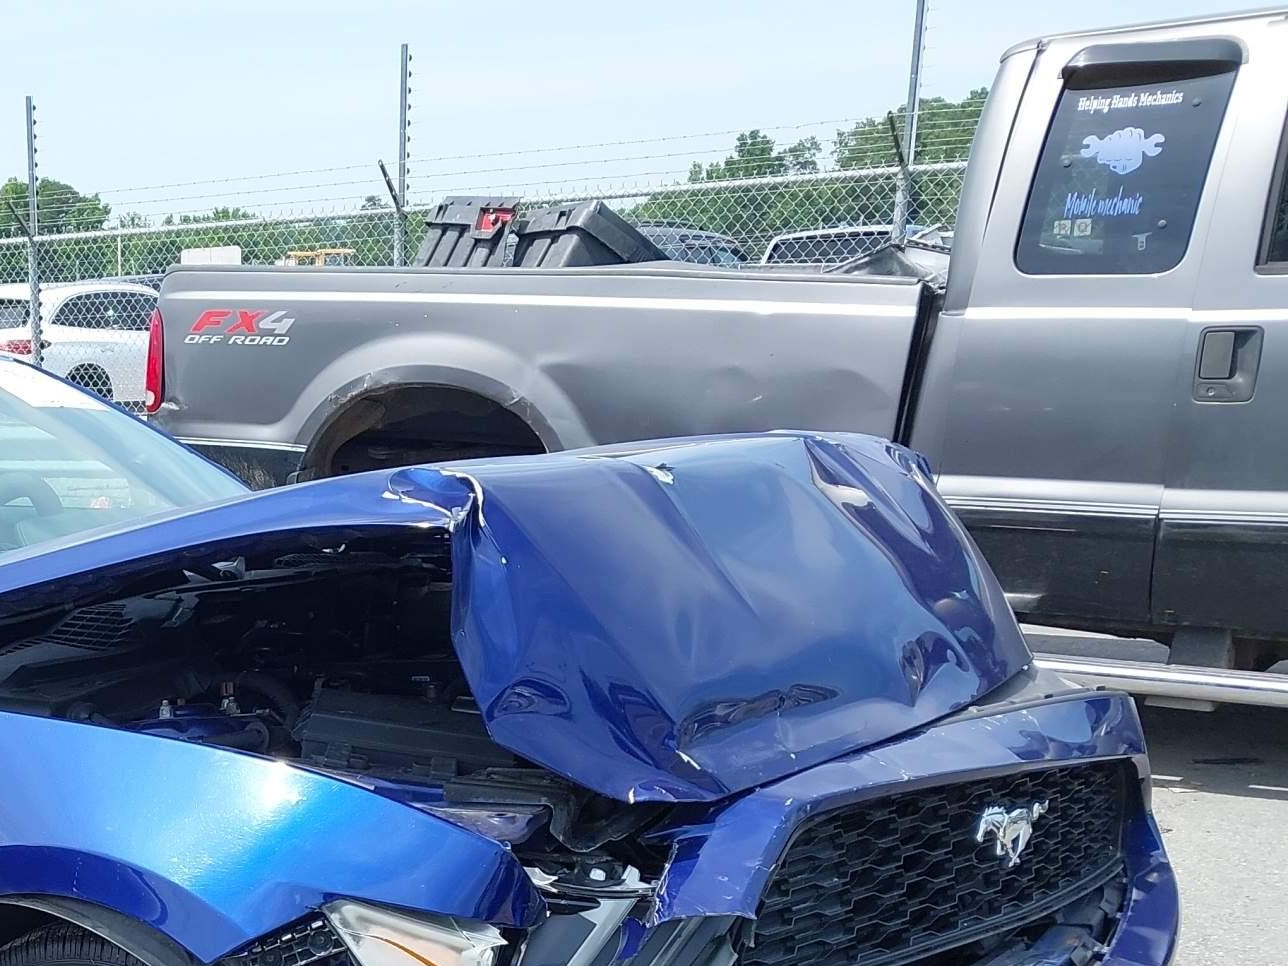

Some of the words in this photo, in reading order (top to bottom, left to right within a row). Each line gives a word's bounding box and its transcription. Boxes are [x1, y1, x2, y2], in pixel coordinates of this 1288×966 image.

[1078, 95, 1112, 114] Helping
[1111, 93, 1139, 109] Hands
[1138, 89, 1185, 107] Mechanics
[190, 308, 296, 334] FX4
[184, 334, 225, 345] OFF
[227, 335, 290, 346] ROAD
